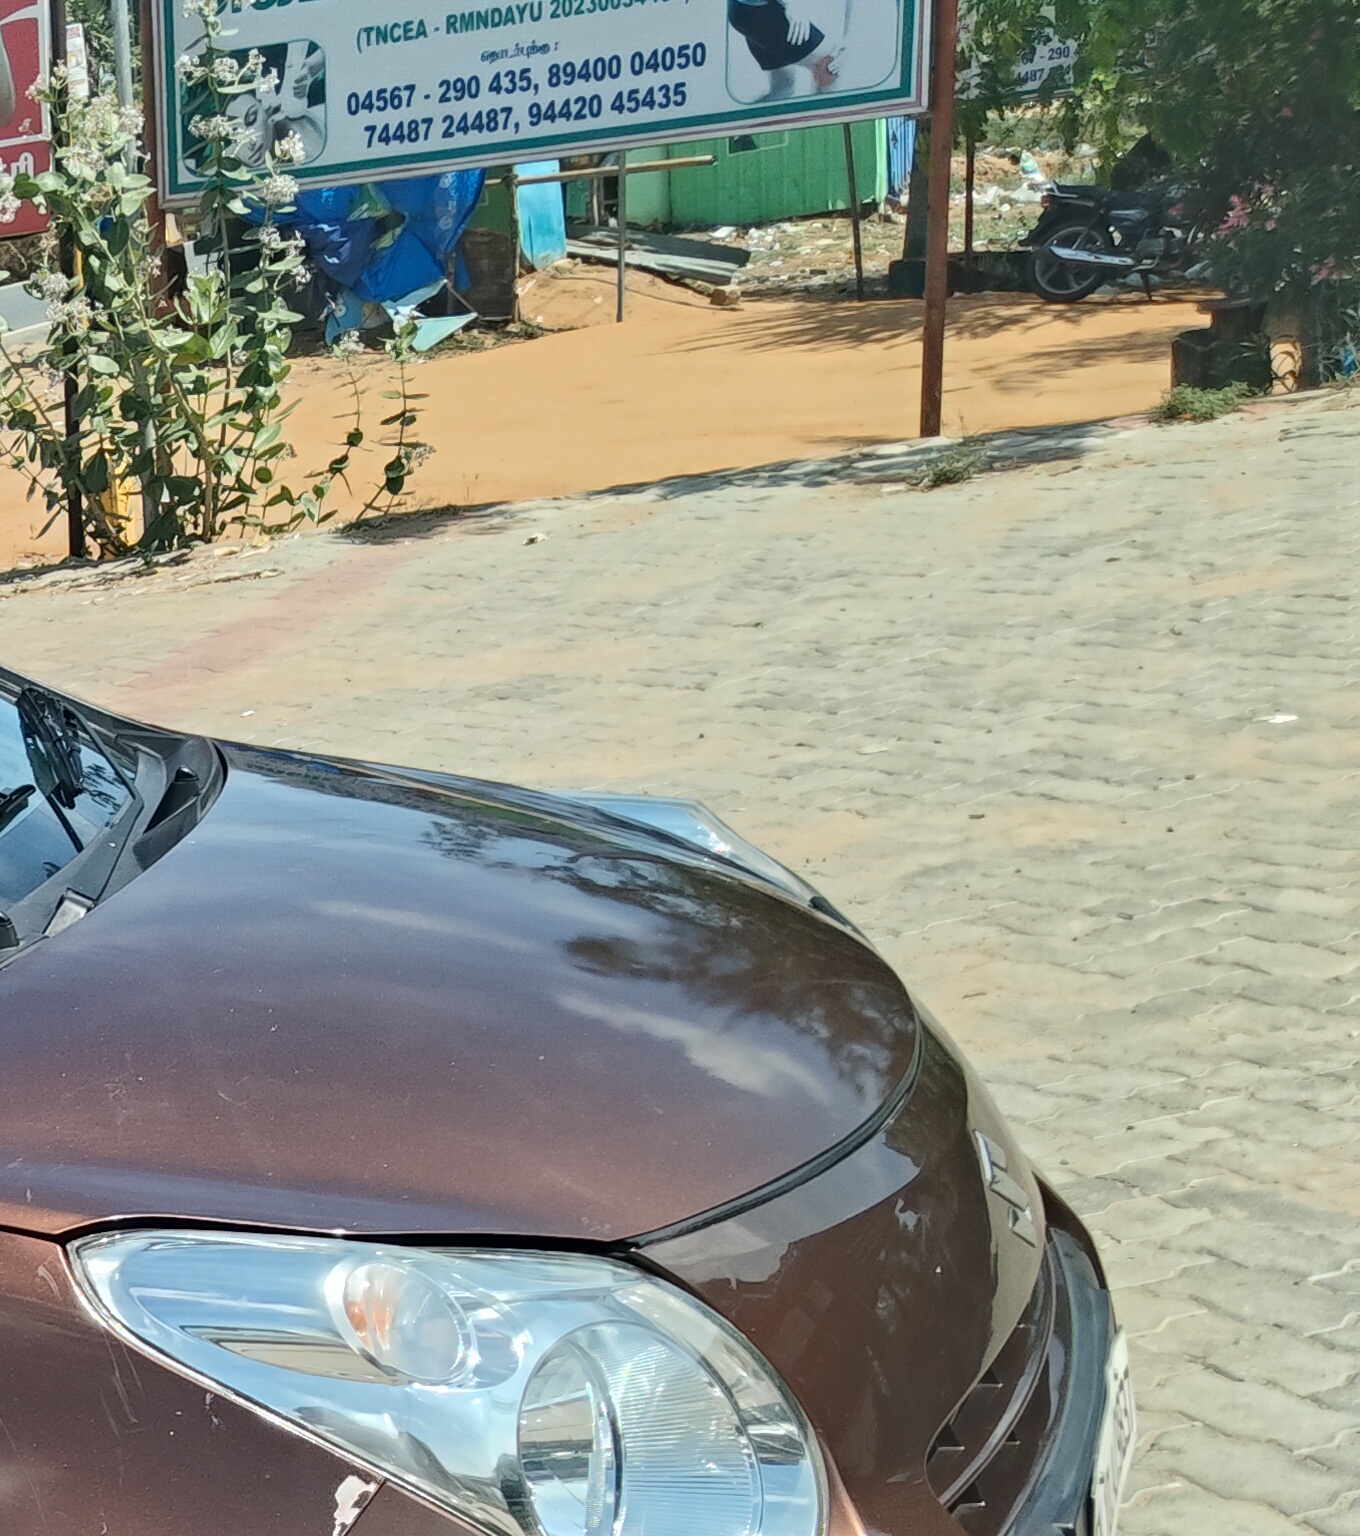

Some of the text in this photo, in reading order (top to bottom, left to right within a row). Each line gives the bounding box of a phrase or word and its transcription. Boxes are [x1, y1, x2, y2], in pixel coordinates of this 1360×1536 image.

[356, 19, 428, 54] (TNCEA
[446, 0, 543, 35] RMNDAYU
[1047, 45, 1070, 61] 290
[347, 84, 416, 115] 04567
[438, 75, 480, 103] 290
[488, 68, 539, 96] 435,
[548, 55, 621, 88] 89400
[630, 42, 706, 76] 04050
[364, 82, 687, 148] 74487 24487, 94420 45435
